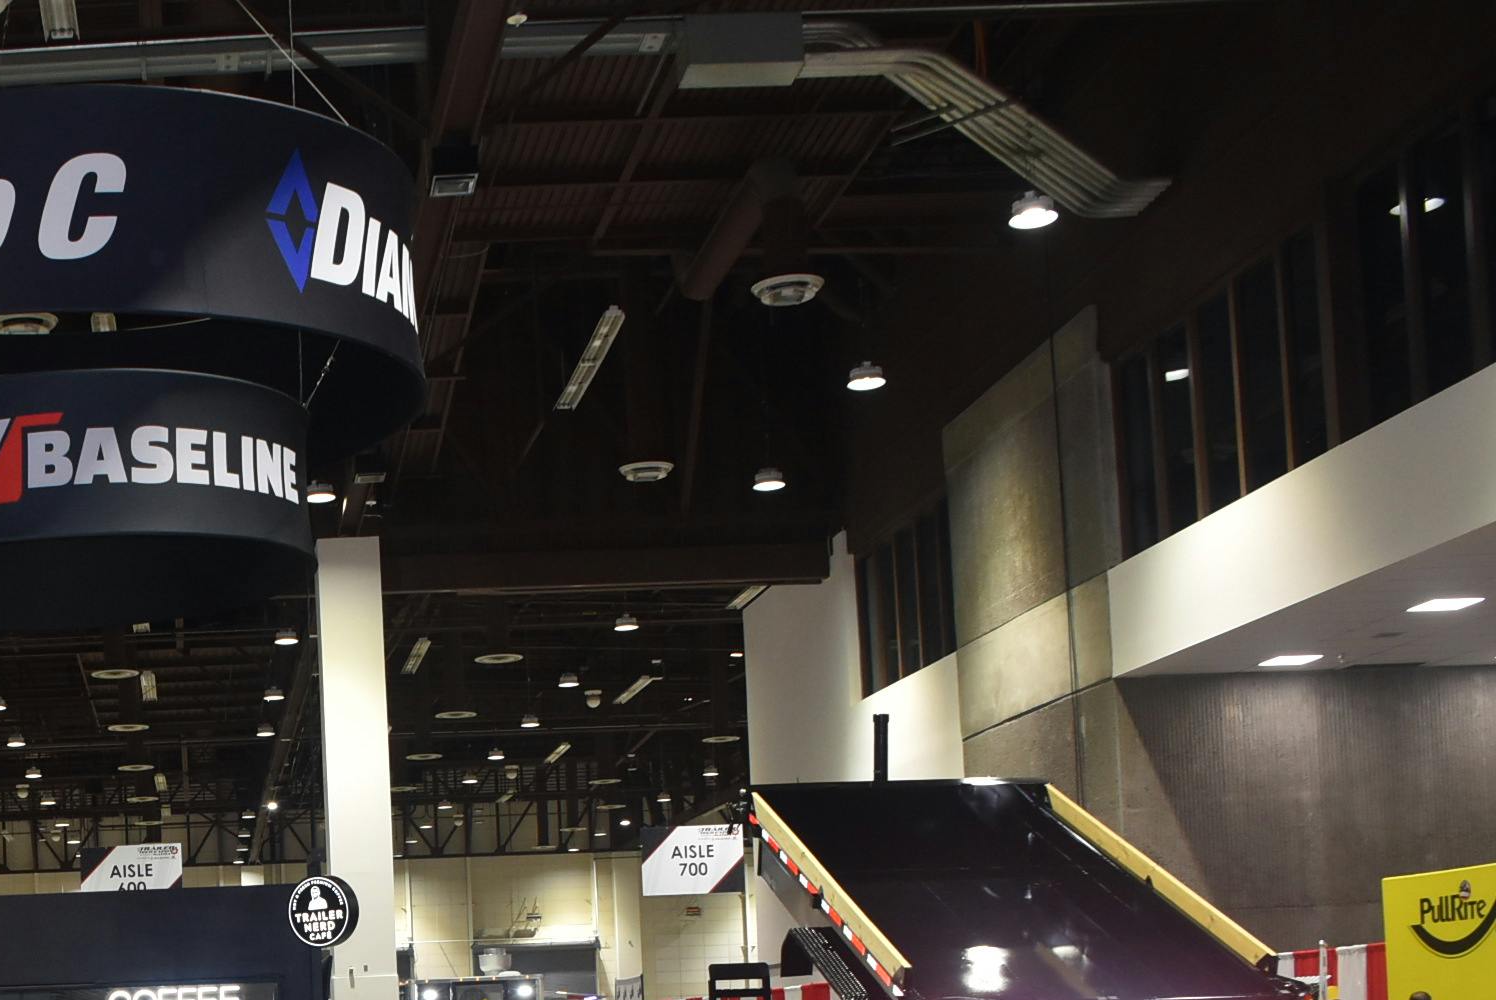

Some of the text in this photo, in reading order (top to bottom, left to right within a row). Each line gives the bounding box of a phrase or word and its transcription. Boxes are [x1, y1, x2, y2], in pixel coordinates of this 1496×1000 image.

[38, 153, 127, 260] C
[26, 425, 300, 505] BASELINE
[671, 844, 715, 859] AISLE
[110, 863, 153, 878] AISLE
[679, 862, 708, 876] 700
[294, 909, 344, 923] TRAILER
[304, 920, 336, 933] NERD
